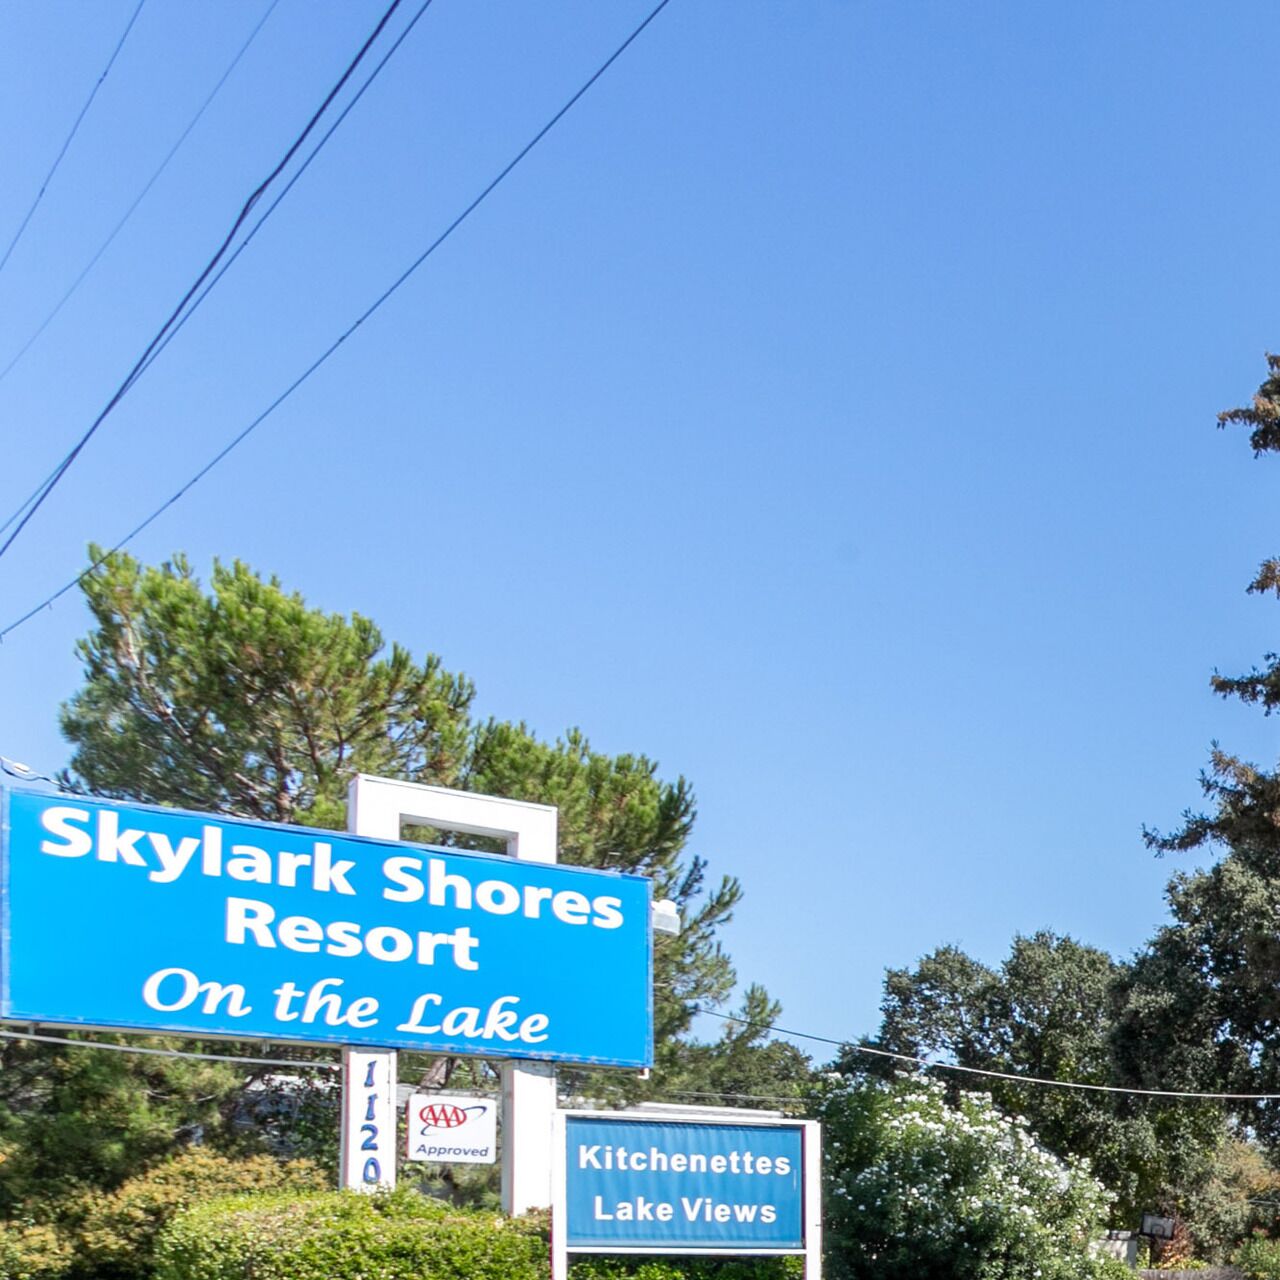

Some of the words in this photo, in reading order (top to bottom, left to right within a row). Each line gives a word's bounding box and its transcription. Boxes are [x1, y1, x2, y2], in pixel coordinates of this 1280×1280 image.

[41, 806, 357, 895] Skylark
[382, 856, 624, 929] Shores
[226, 897, 480, 971] Resort
[142, 967, 252, 1018] On
[273, 978, 379, 1028] the
[396, 993, 549, 1043] Lake
[360, 1060, 382, 1184] 1120
[424, 1103, 463, 1128] AAA
[416, 1143, 490, 1157] Approved
[579, 1145, 791, 1175] Kitchenettes
[594, 1195, 674, 1221] Lake
[681, 1197, 777, 1223] Views
